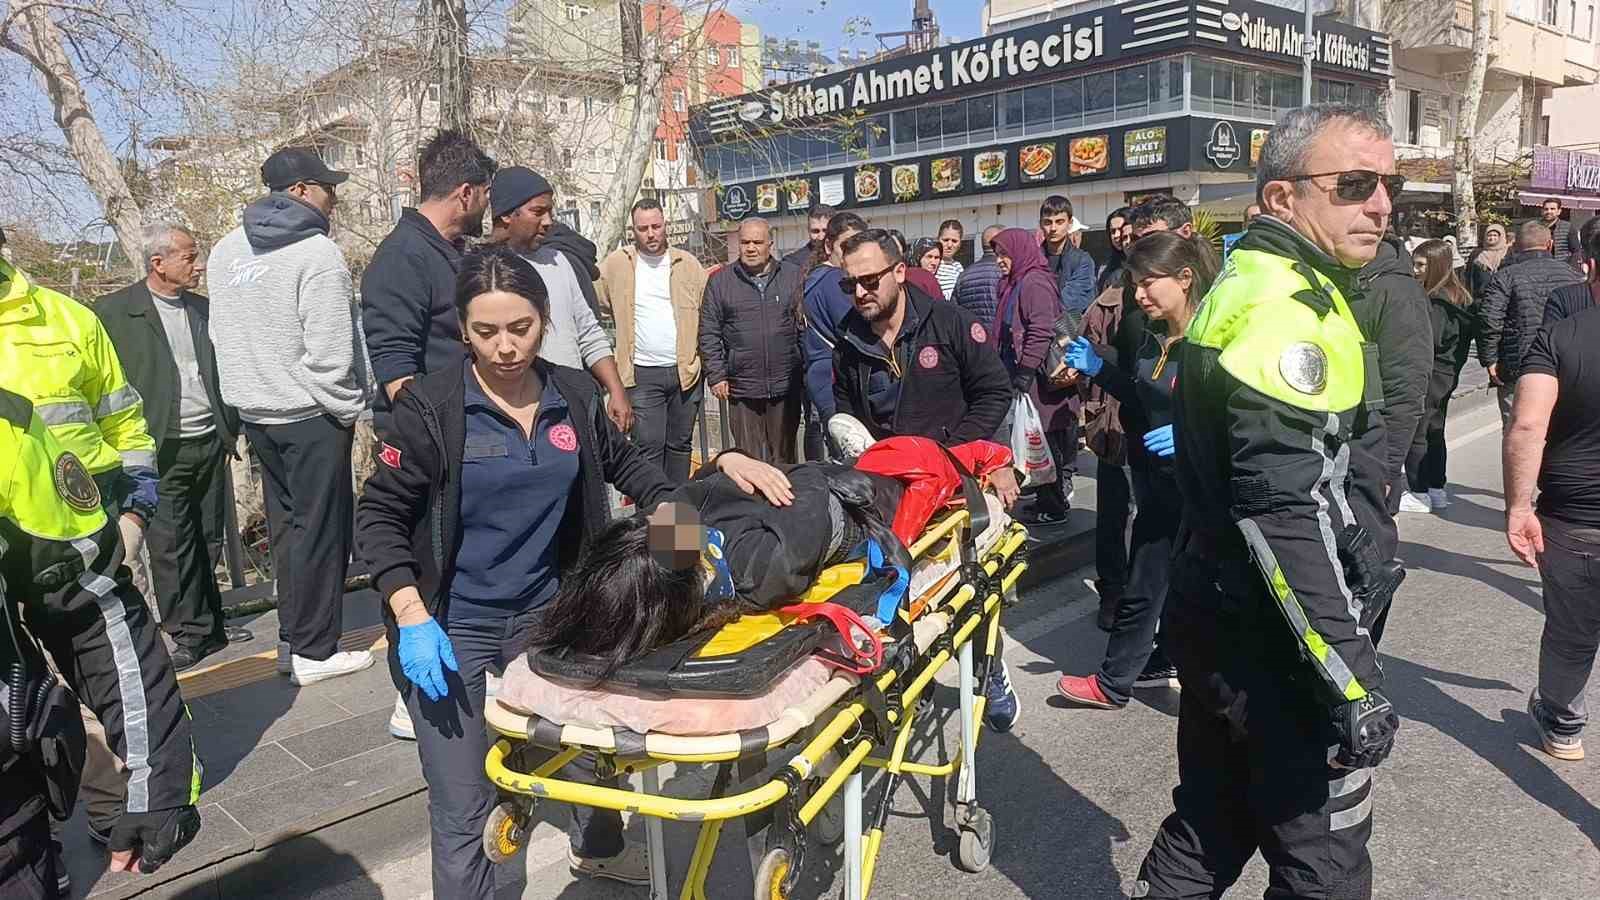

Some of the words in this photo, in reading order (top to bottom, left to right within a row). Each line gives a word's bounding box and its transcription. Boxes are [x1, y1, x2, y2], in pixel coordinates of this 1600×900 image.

[1240, 12, 1281, 52] Sultan
[1324, 33, 1370, 71] Köftecisi
[770, 84, 845, 122] Sultan
[851, 54, 944, 107] Ahmet
[951, 16, 1103, 86] Köftecisi
[1130, 142, 1160, 153] PAKET
[1135, 130, 1155, 140] ALO
